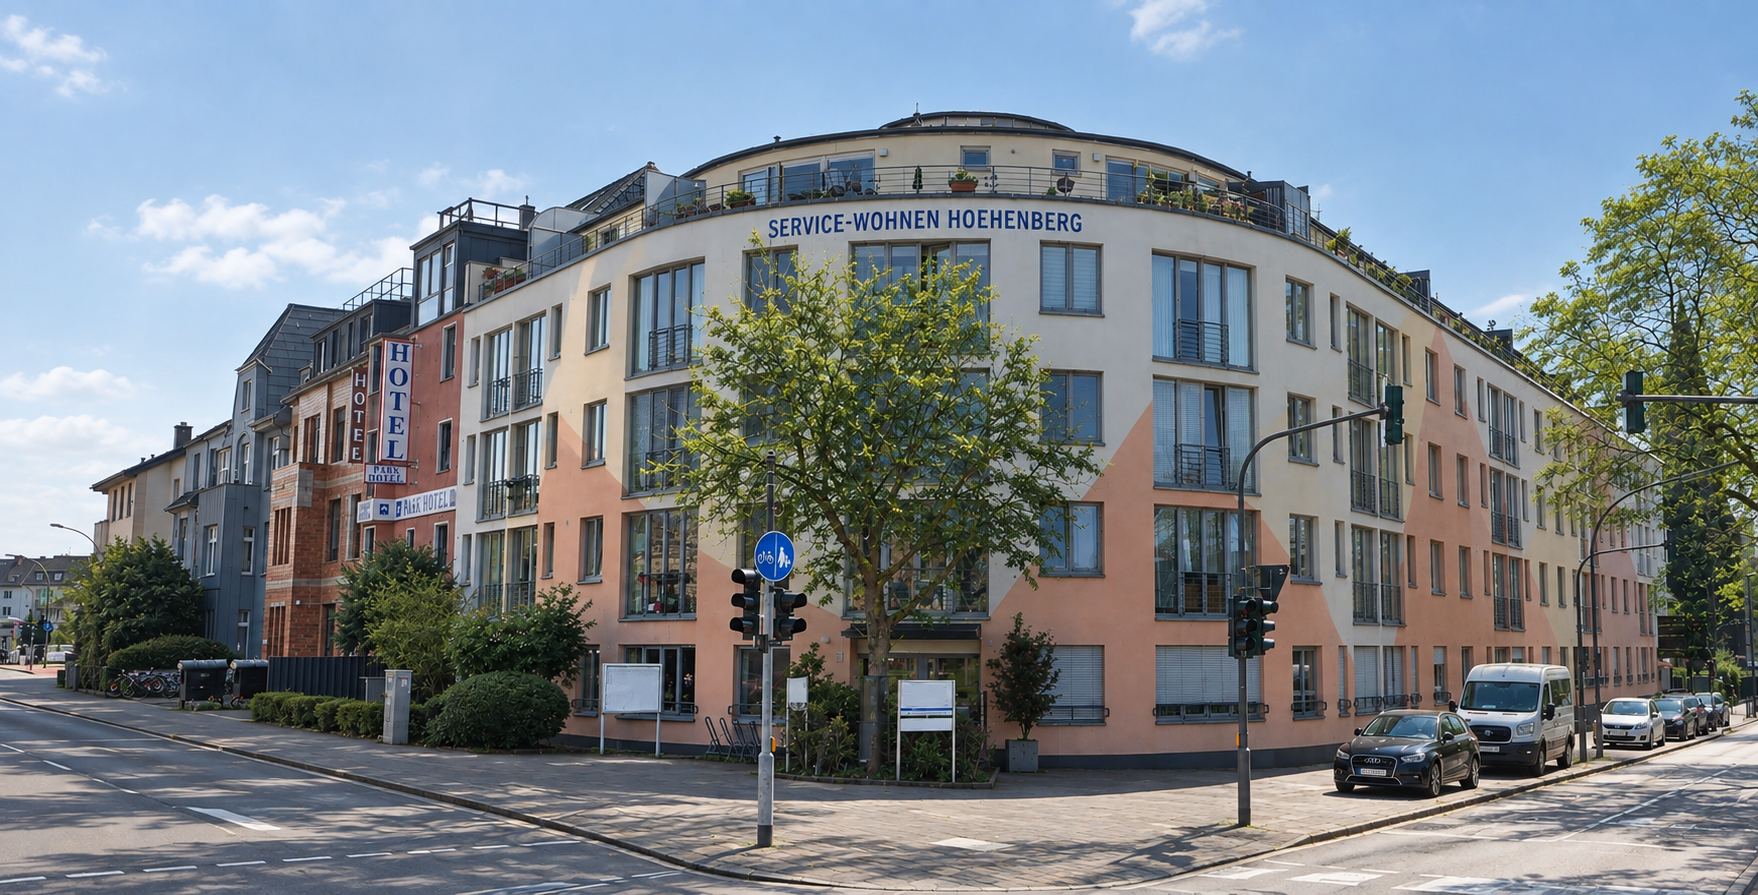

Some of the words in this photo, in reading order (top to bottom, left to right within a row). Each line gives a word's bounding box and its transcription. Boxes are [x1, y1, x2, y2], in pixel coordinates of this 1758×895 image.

[768, 210, 939, 239] SERVICE-WOHNEN
[948, 209, 1083, 233] HOEHENBERG
[386, 342, 410, 460] HOTEL
[422, 490, 449, 512] HOTEL
